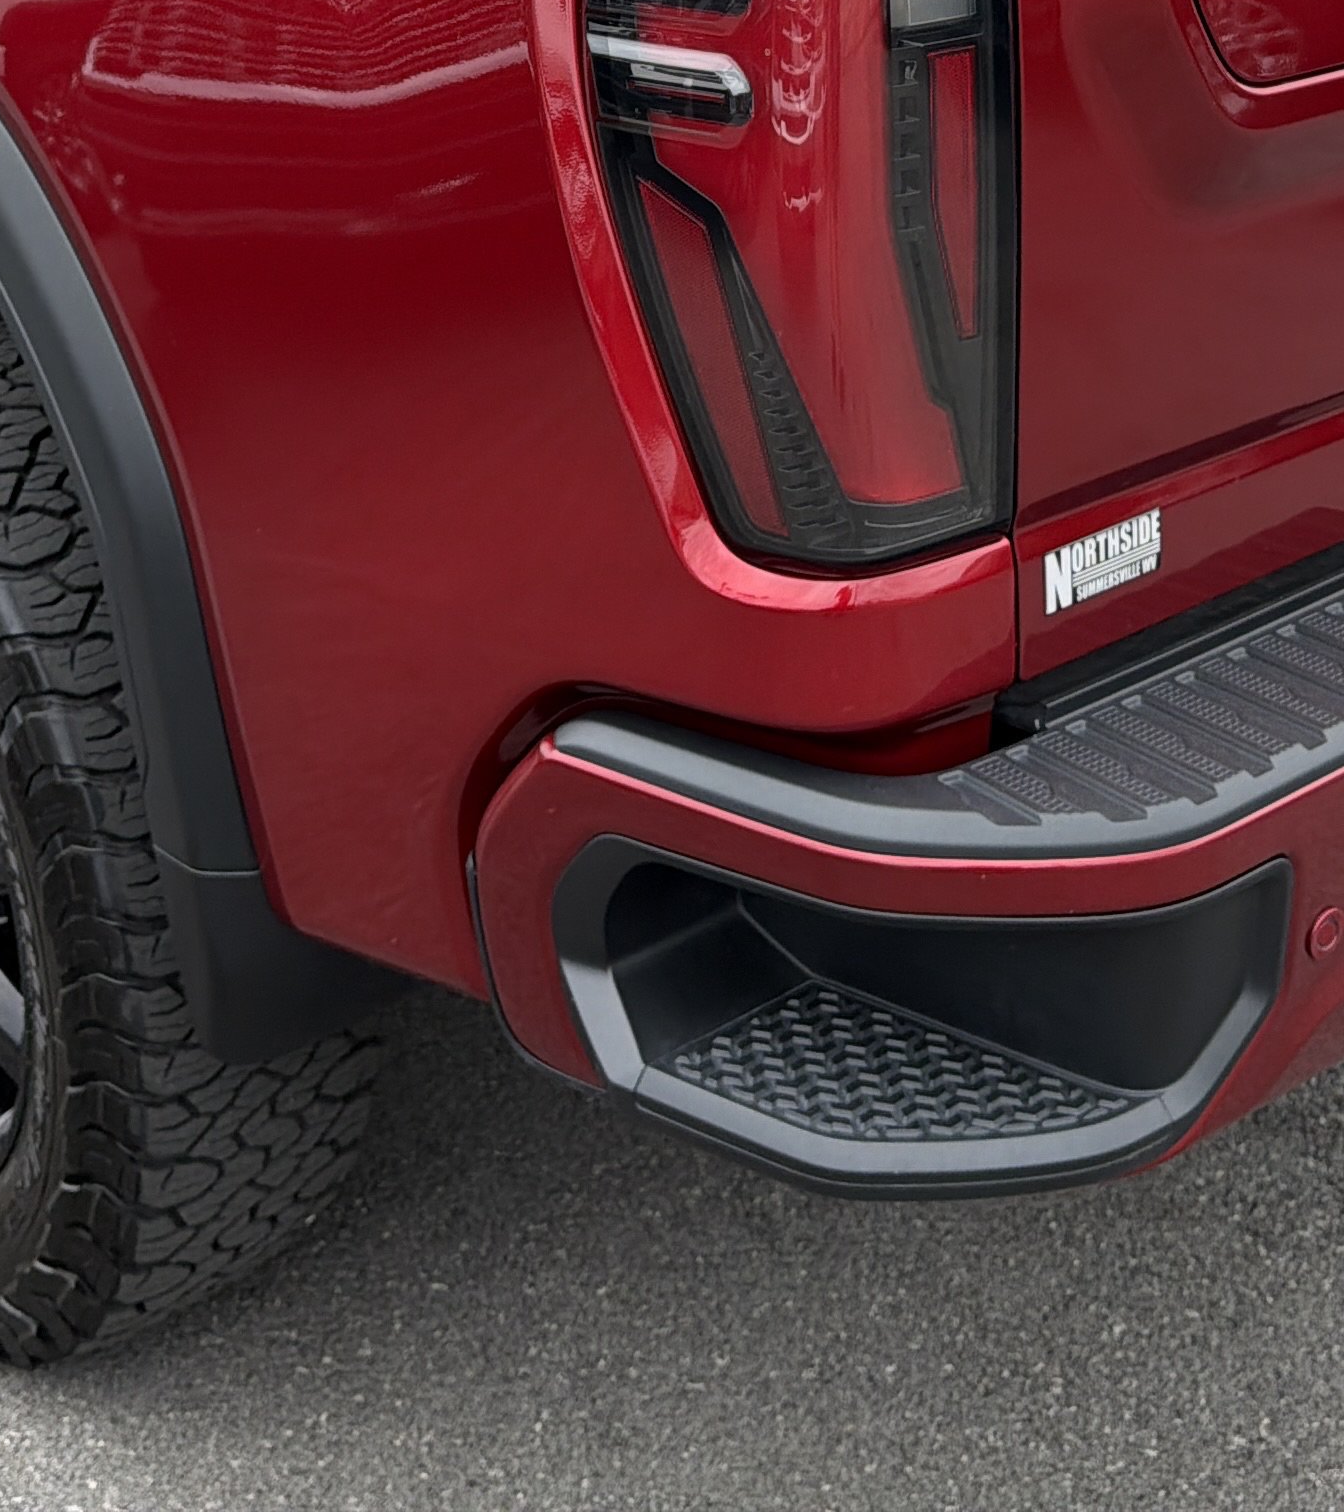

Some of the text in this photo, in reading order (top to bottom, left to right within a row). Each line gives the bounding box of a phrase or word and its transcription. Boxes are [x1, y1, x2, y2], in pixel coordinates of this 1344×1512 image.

[1044, 506, 1161, 616] NORTHSIDE
[1076, 553, 1158, 603] SUMMERSVILLE WV
